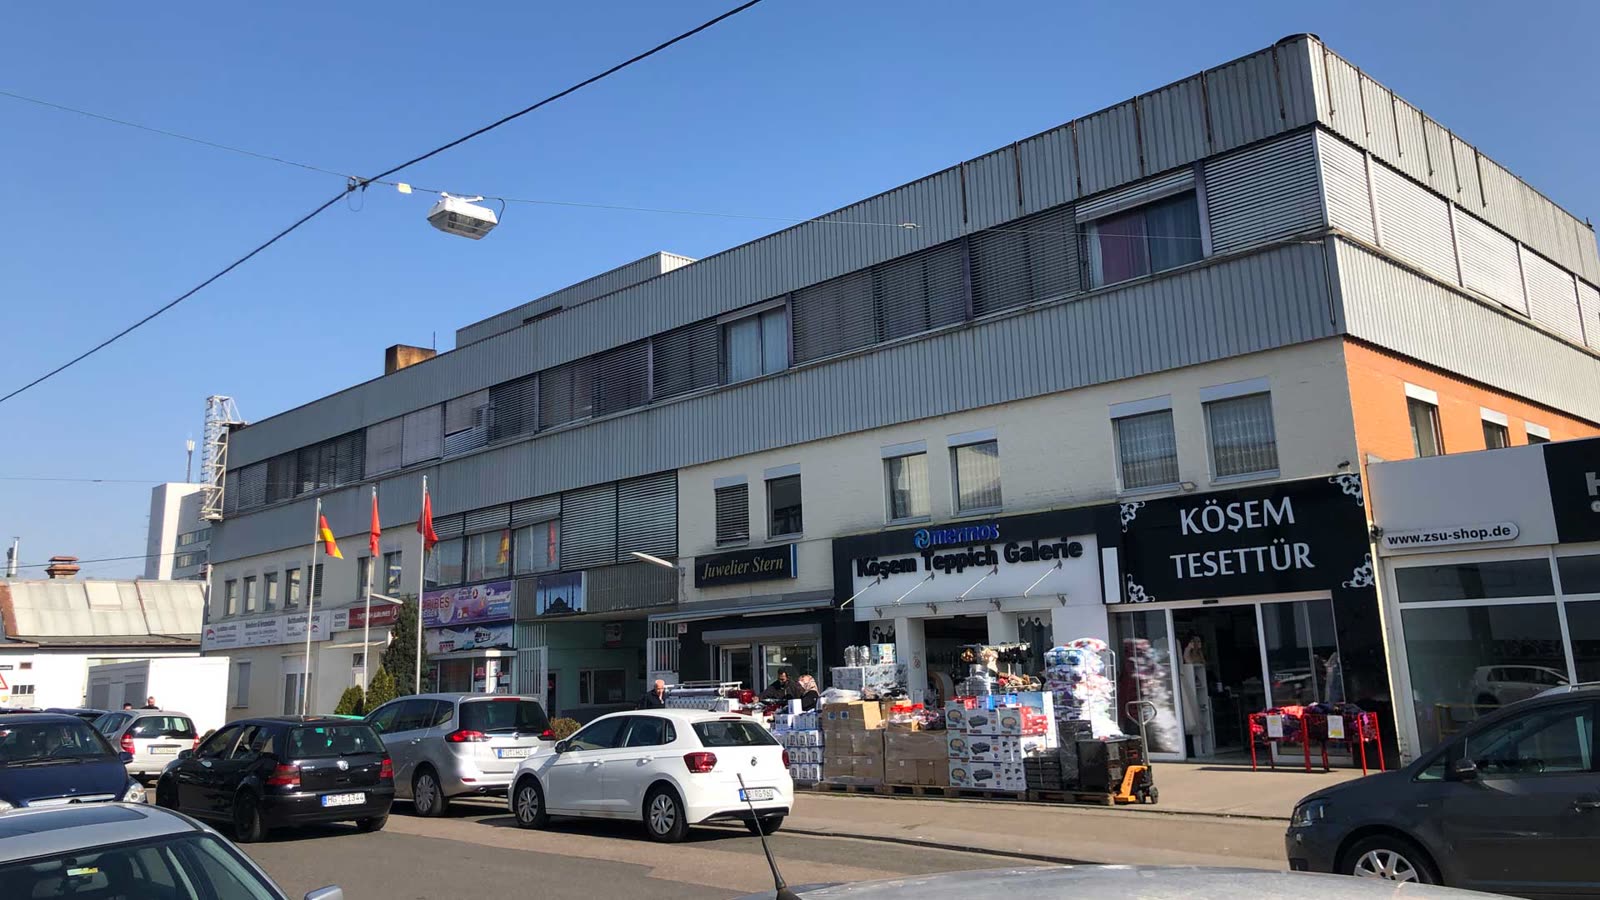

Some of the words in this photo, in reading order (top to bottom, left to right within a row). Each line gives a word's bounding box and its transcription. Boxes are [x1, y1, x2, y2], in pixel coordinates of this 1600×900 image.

[1180, 496, 1296, 536] KÖŞEM
[1387, 525, 1511, 545] www.zsu-shop.de
[702, 560, 749, 580] Juwelier
[752, 556, 784, 573] Stern
[857, 556, 917, 580] Köşem
[921, 545, 999, 574] Teppich
[1003, 536, 1084, 564] Galerie
[1170, 538, 1316, 579] TESETTÜR
